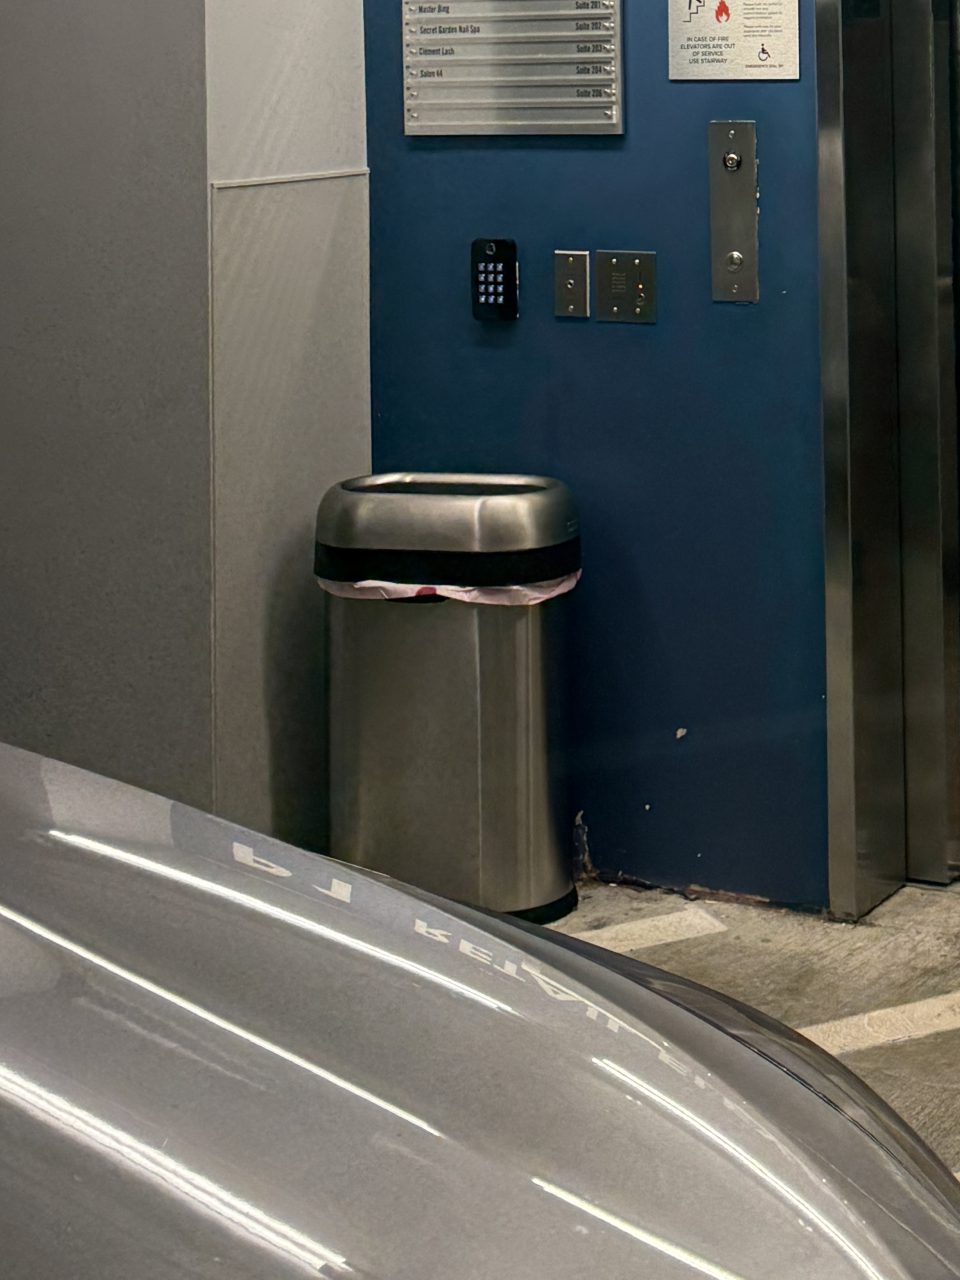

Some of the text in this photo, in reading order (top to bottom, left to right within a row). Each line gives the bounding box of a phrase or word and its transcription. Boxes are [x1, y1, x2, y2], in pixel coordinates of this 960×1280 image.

[575, 1, 590, 9] Suite
[420, 25, 480, 34] Secret Garden Nail Spa
[575, 22, 590, 30] Suite
[576, 44, 590, 53] Suite
[576, 66, 590, 74] Suite
[576, 89, 590, 98] Suite
